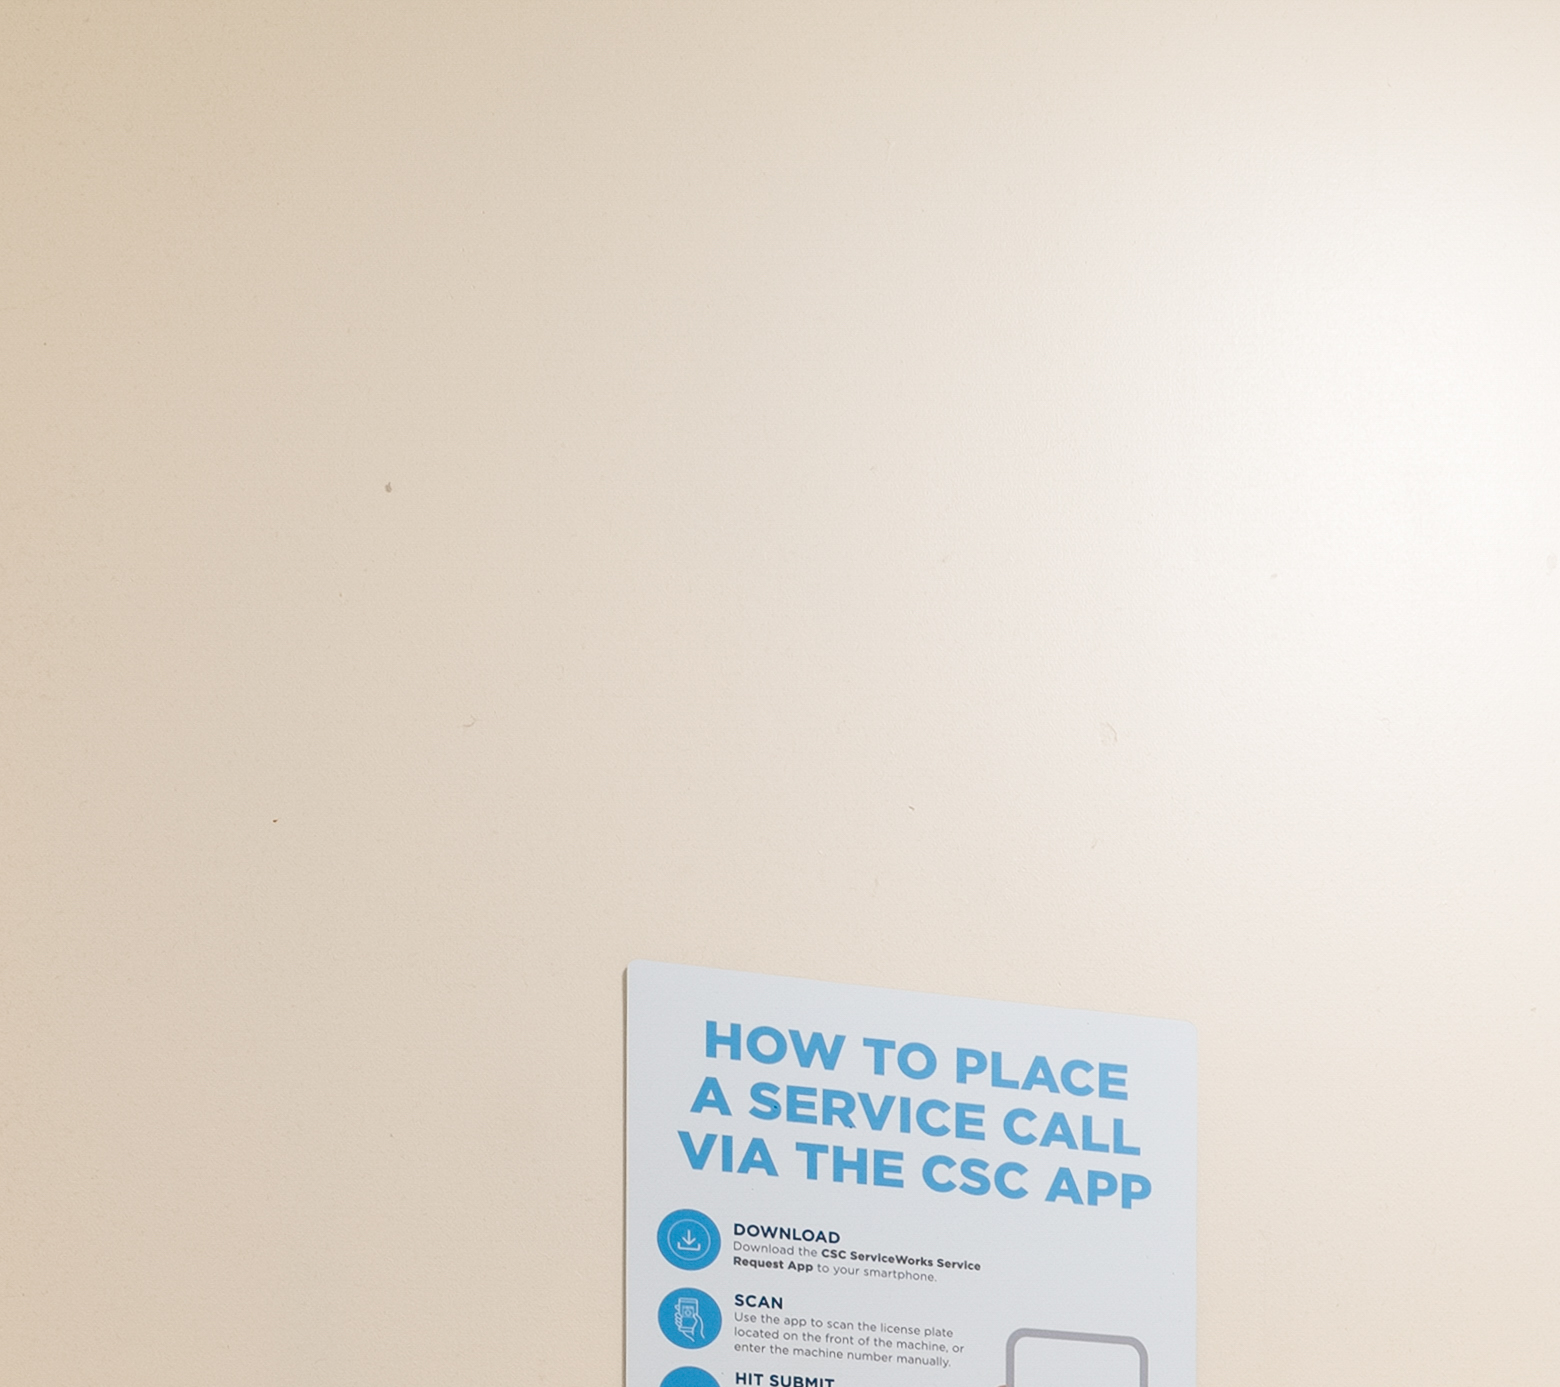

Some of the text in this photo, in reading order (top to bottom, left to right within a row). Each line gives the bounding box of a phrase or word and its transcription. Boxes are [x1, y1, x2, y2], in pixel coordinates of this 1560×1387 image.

[705, 1019, 1128, 1101] HOW TO PLACE
[689, 1076, 1141, 1156] A SERVICE CALL
[677, 1130, 1152, 1209] VIA THE CSC APP
[733, 1223, 841, 1244] DOWNLOAD
[734, 1293, 783, 1310] SCAN
[735, 1372, 764, 1387] HIT
